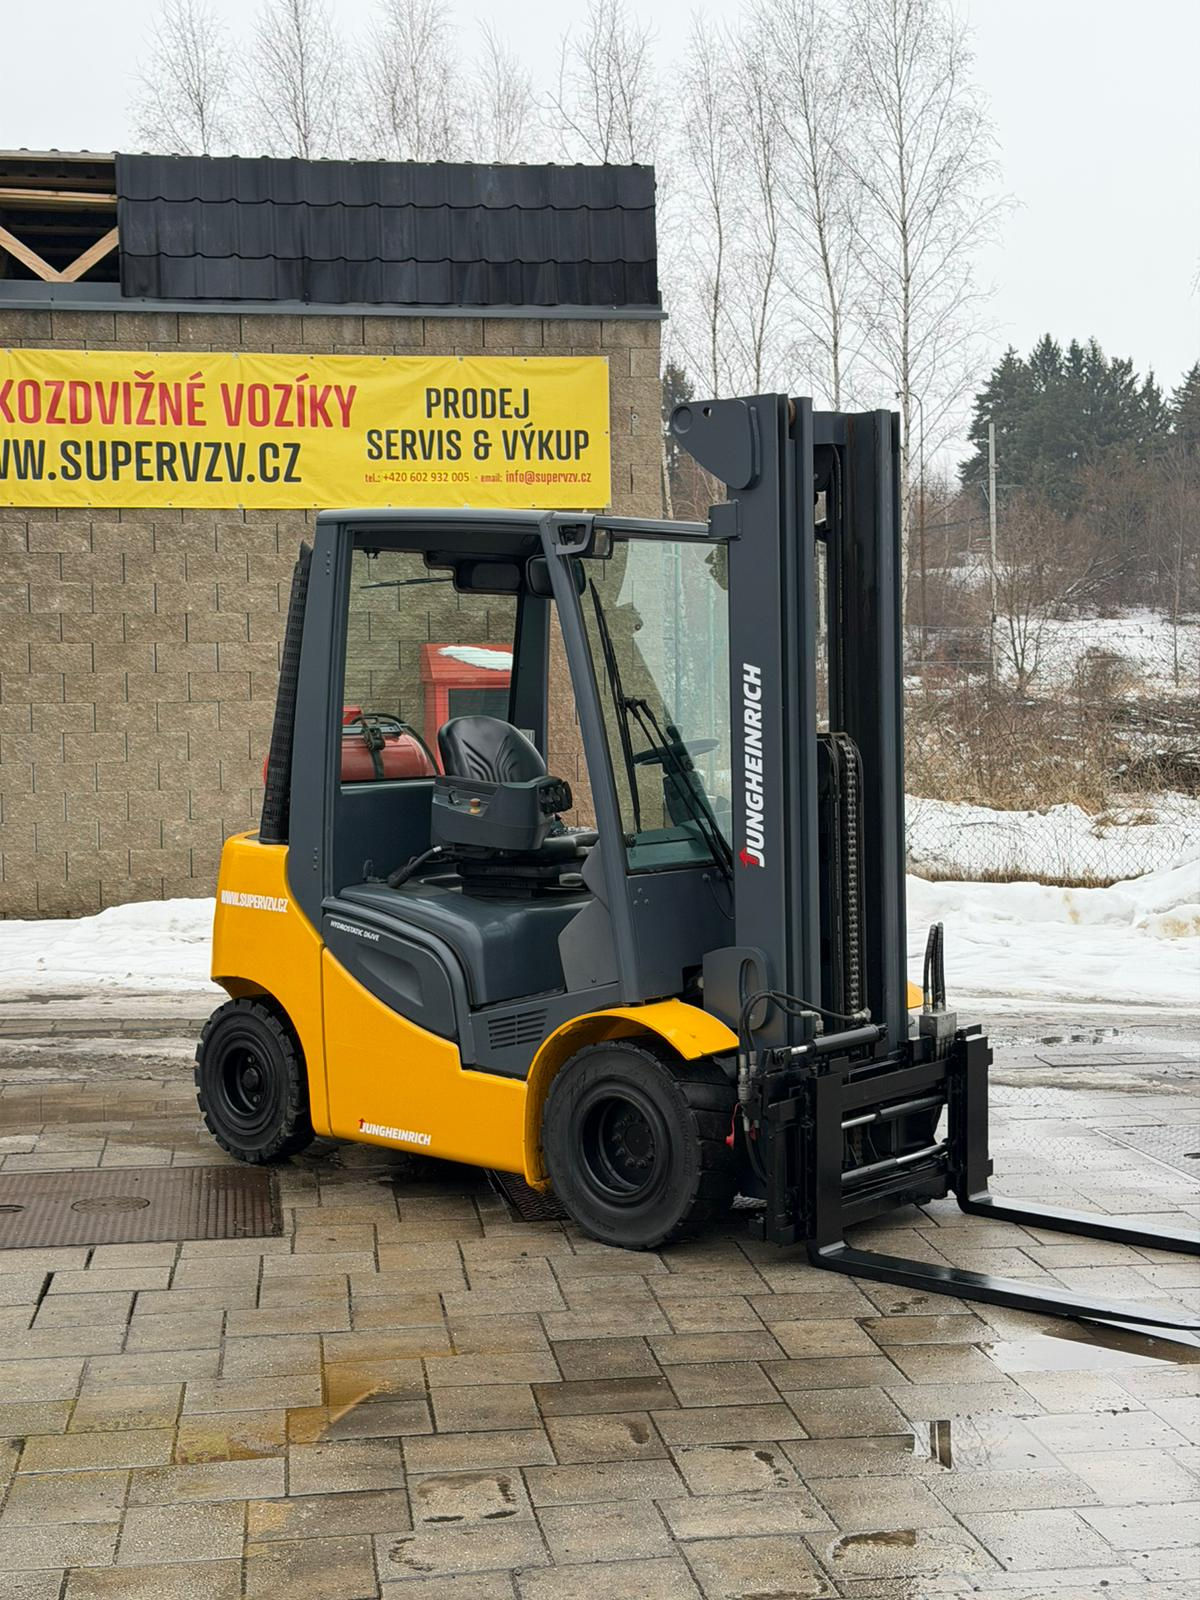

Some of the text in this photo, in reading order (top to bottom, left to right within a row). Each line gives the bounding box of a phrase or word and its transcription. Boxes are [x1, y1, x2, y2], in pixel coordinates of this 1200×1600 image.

[221, 372, 357, 428] VOZÍKY
[426, 387, 530, 419] PRODEJ
[367, 421, 590, 461] SERVIS & VÝKUP
[384, 472, 407, 482] +420
[410, 472, 428, 482] 602
[431, 472, 448, 482] 932
[451, 472, 470, 482] 005
[505, 470, 592, 486] info@supervzv.cz
[740, 663, 765, 868] JUNGHEINRICH
[221, 890, 288, 912] WWW.SUPERVZV.CZ
[359, 1119, 431, 1146] JUNGHEINRICH
